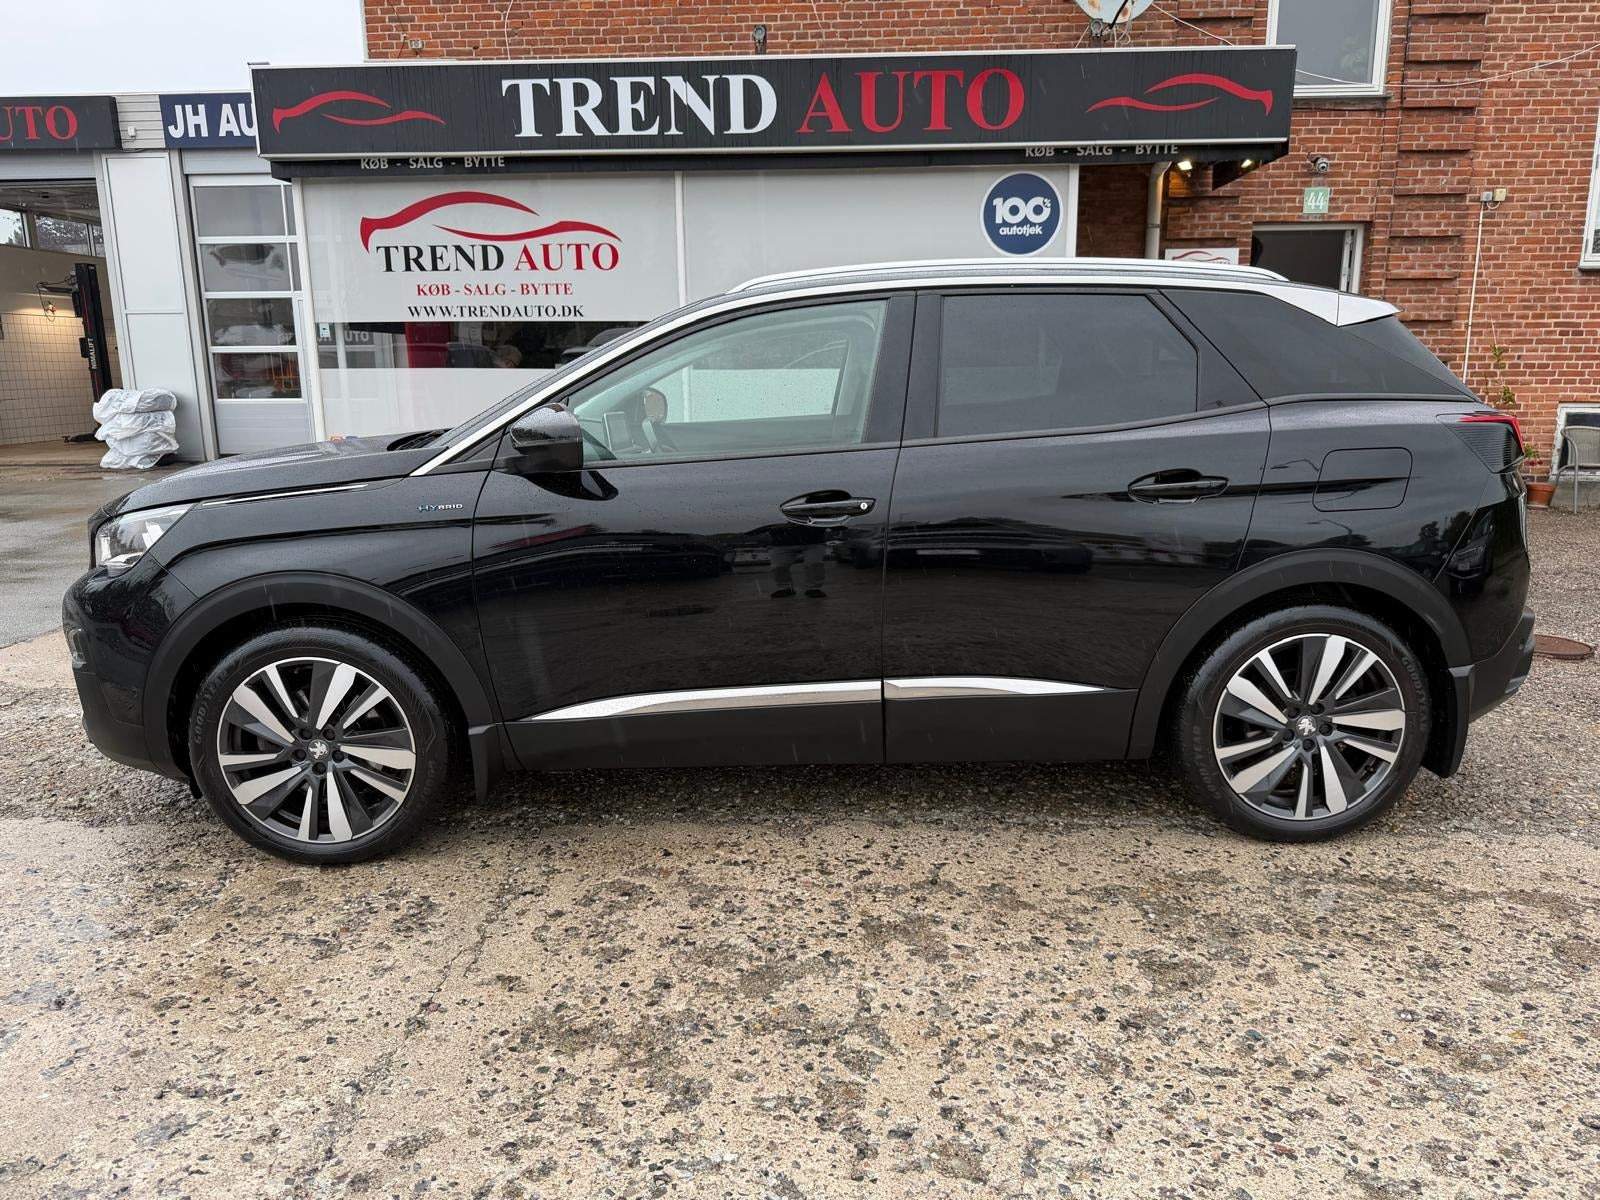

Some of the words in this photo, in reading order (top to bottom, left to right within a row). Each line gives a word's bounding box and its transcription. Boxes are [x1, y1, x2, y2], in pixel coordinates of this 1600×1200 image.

[502, 74, 777, 137] TREND
[796, 68, 1025, 133] AUTO
[168, 104, 209, 139] JH
[1025, 146, 1055, 157] KØB
[1076, 145, 1113, 156] SALG
[1135, 144, 1178, 155] BYTTE
[361, 157, 389, 169] KØB
[409, 156, 443, 169] SALG
[464, 155, 505, 168] BYTTE
[1307, 191, 1325, 209] 44
[999, 224, 1043, 237] autotjek
[376, 244, 504, 273] TREND
[514, 242, 620, 271] AUTO
[416, 283, 450, 297] KØB
[464, 283, 506, 296] SALG
[520, 282, 573, 296] BYTTE
[408, 304, 584, 318] WWW.TRENDAUTO.DK
[418, 503, 463, 511] HYBRID
